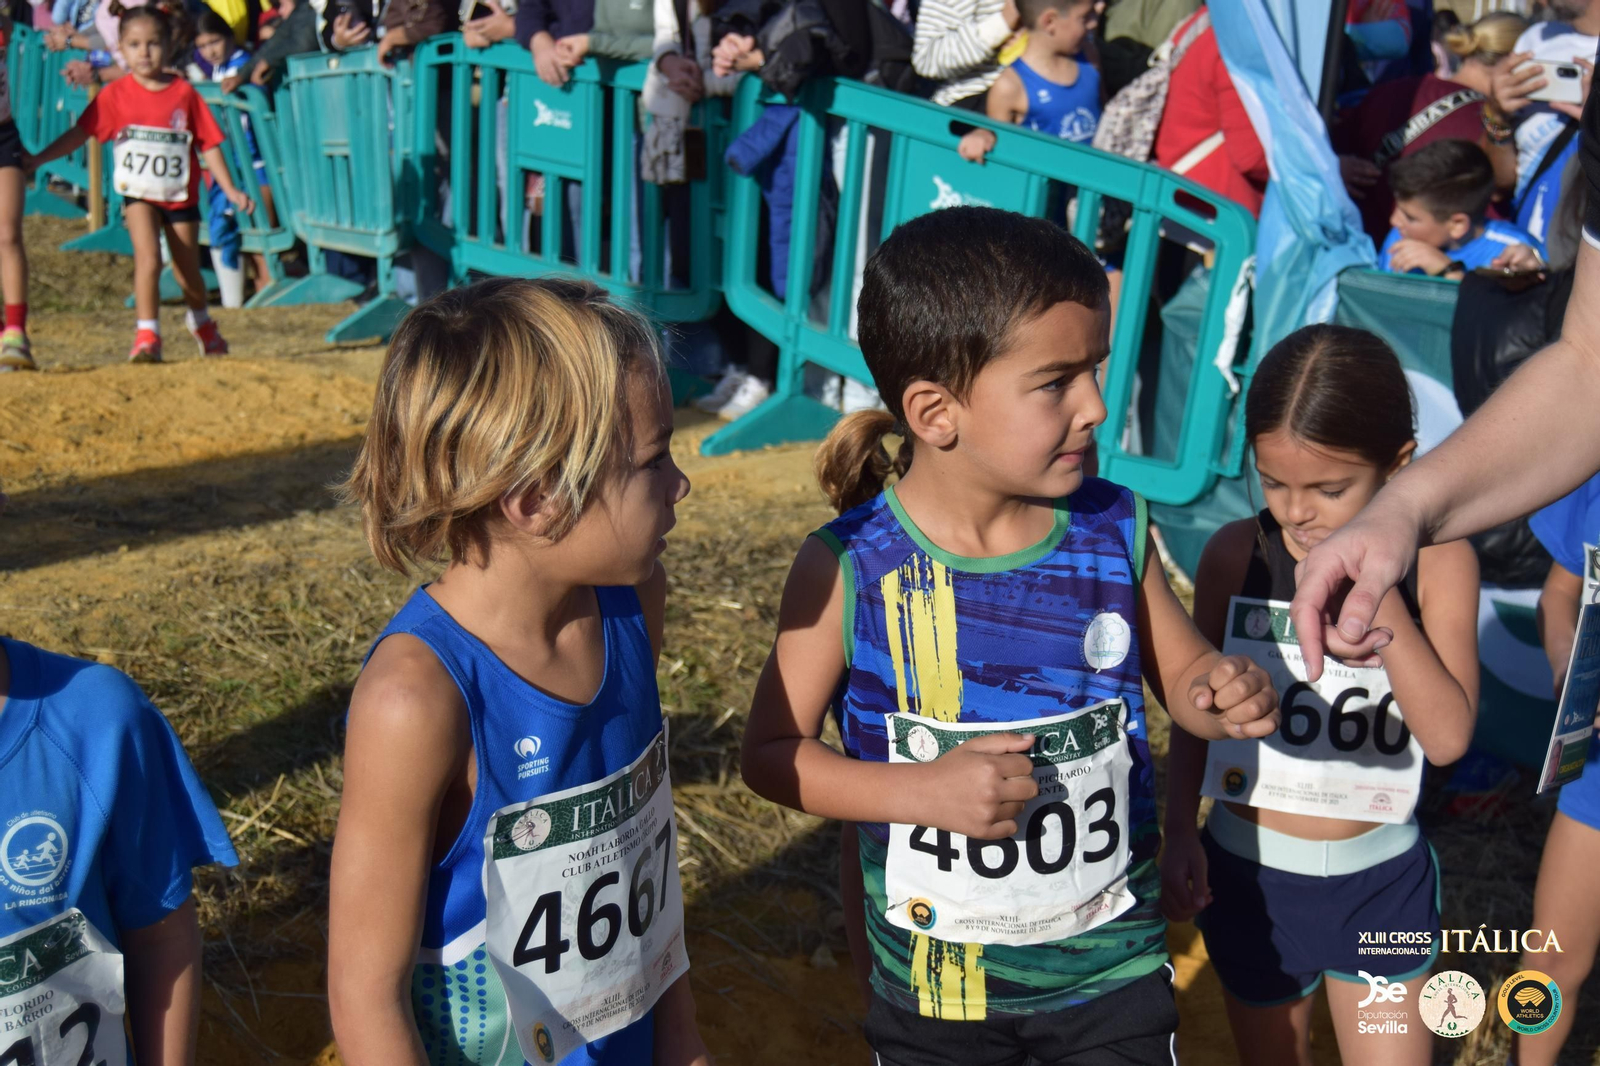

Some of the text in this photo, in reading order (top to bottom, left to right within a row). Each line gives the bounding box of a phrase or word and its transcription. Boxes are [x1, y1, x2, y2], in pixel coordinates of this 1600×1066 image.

[122, 151, 183, 178] 4703
[1259, 681, 1412, 757] 660
[517, 756, 550, 772] SPORTING
[517, 764, 549, 780] PURSUITS
[1038, 765, 1092, 785] PICHARDO
[571, 764, 653, 832] ITÁLICA
[1037, 785, 1065, 797] ENTE
[6, 814, 20, 828] Club
[20, 811, 29, 819] de
[568, 806, 656, 864] NOAH LABORDA GALLO
[908, 786, 1121, 880] 4603
[561, 861, 592, 878] CLUB
[593, 836, 641, 869] ATLETISMO
[9, 884, 37, 897] niños
[38, 884, 54, 895] del
[55, 859, 73, 888] barrio
[4, 891, 69, 911] LA RINCONADA
[512, 817, 672, 975] 4667
[976, 919, 1028, 930] INTERNACIONAL
[990, 927, 1027, 936] NOVIEMBRE
[1038, 924, 1052, 933] 2025
[6, 972, 46, 994] COUNTRY
[4, 1003, 54, 1032] BARRIO
[562, 1016, 582, 1030] CROSS
[582, 998, 628, 1021] INTERNACIONAL
[585, 1019, 594, 1028] DE
[594, 1005, 628, 1024] NOVIEMBRE
